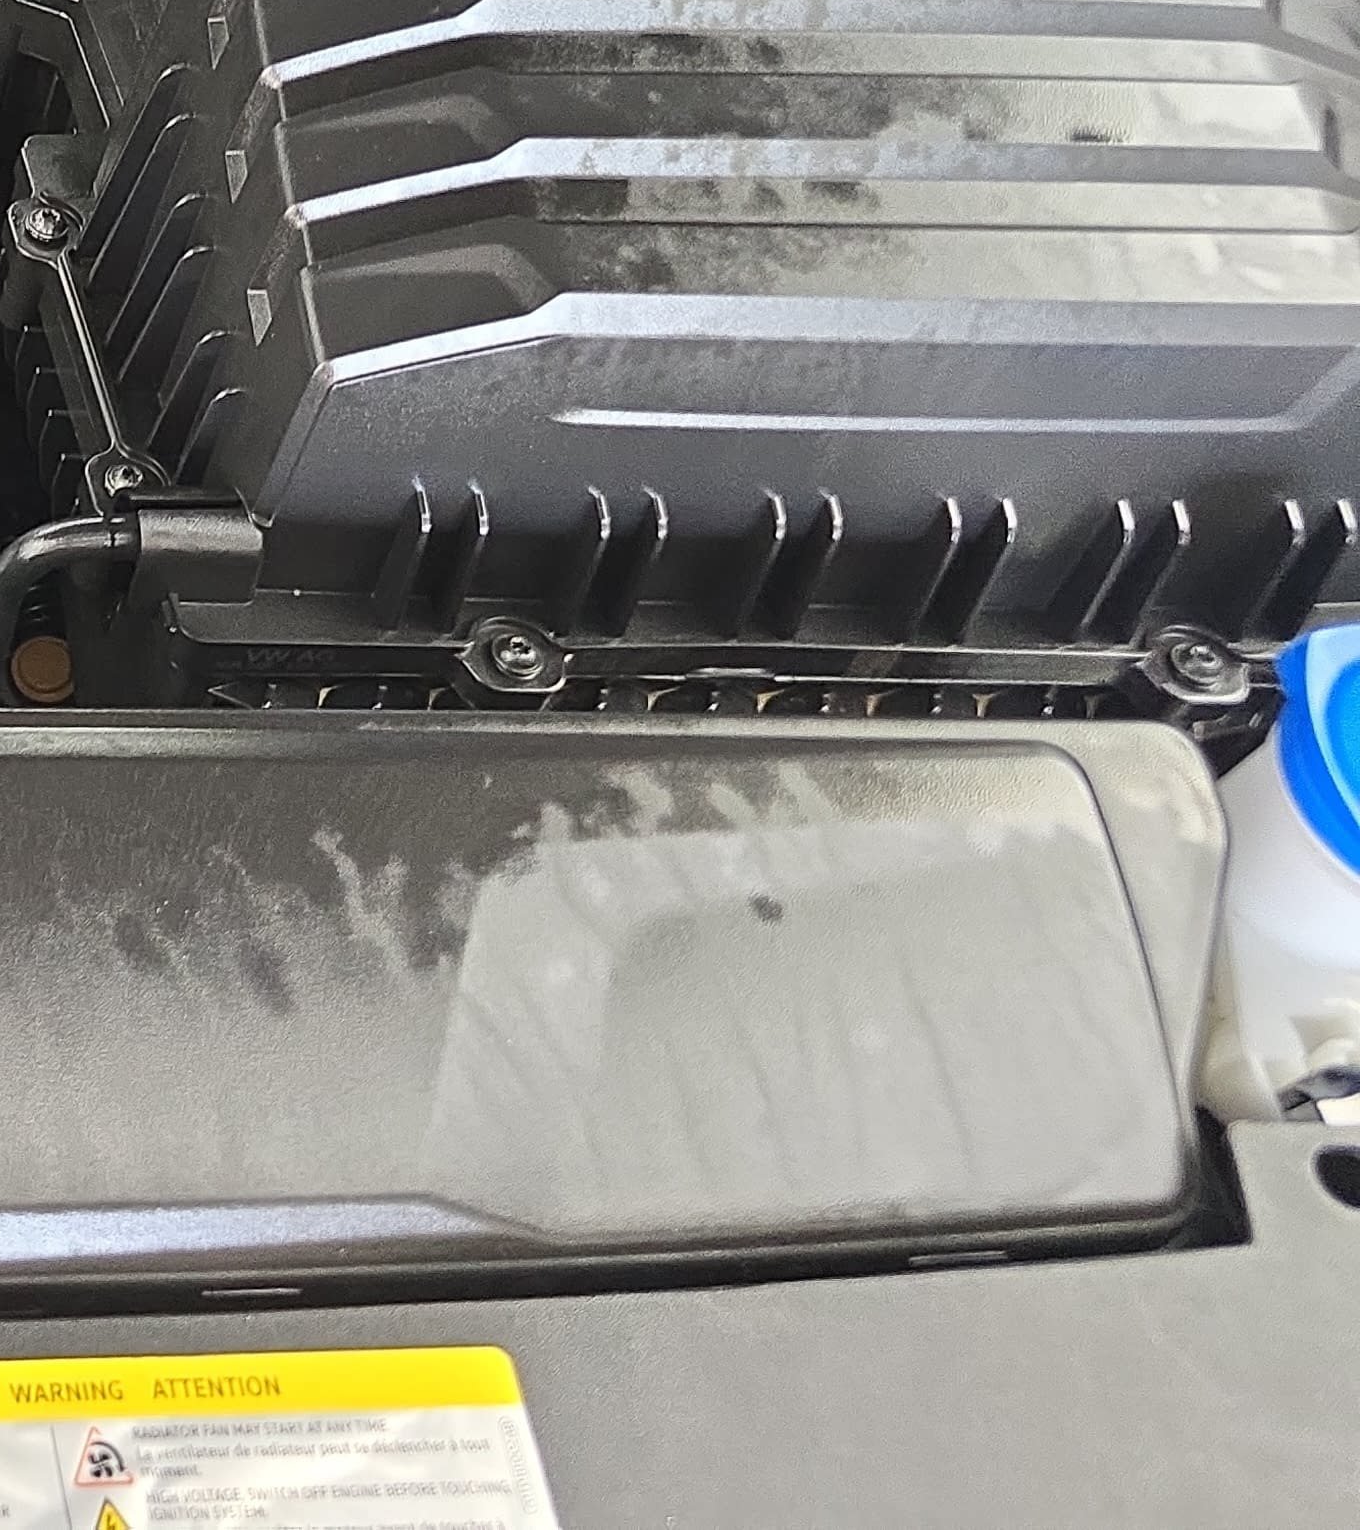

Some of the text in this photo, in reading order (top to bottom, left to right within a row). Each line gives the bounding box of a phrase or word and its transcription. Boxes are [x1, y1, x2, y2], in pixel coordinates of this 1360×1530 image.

[9, 1375, 281, 1404] WARNING ATTENTION
[132, 1423, 200, 1440] RADIATOR
[203, 1422, 230, 1438] FAN
[232, 1422, 260, 1437] MAY
[262, 1421, 304, 1436] START
[307, 1420, 323, 1435] AT
[327, 1419, 352, 1433] ANY
[157, 1443, 230, 1461] ventilateur
[234, 1442, 252, 1457] de
[254, 1440, 317, 1457] radiateur
[145, 1487, 180, 1505] HIGH
[330, 1481, 382, 1499] ENGINE
[383, 1479, 437, 1498] BEFORE
[439, 1478, 513, 1496] TOUCHING
[147, 1504, 210, 1520] IGNITION
